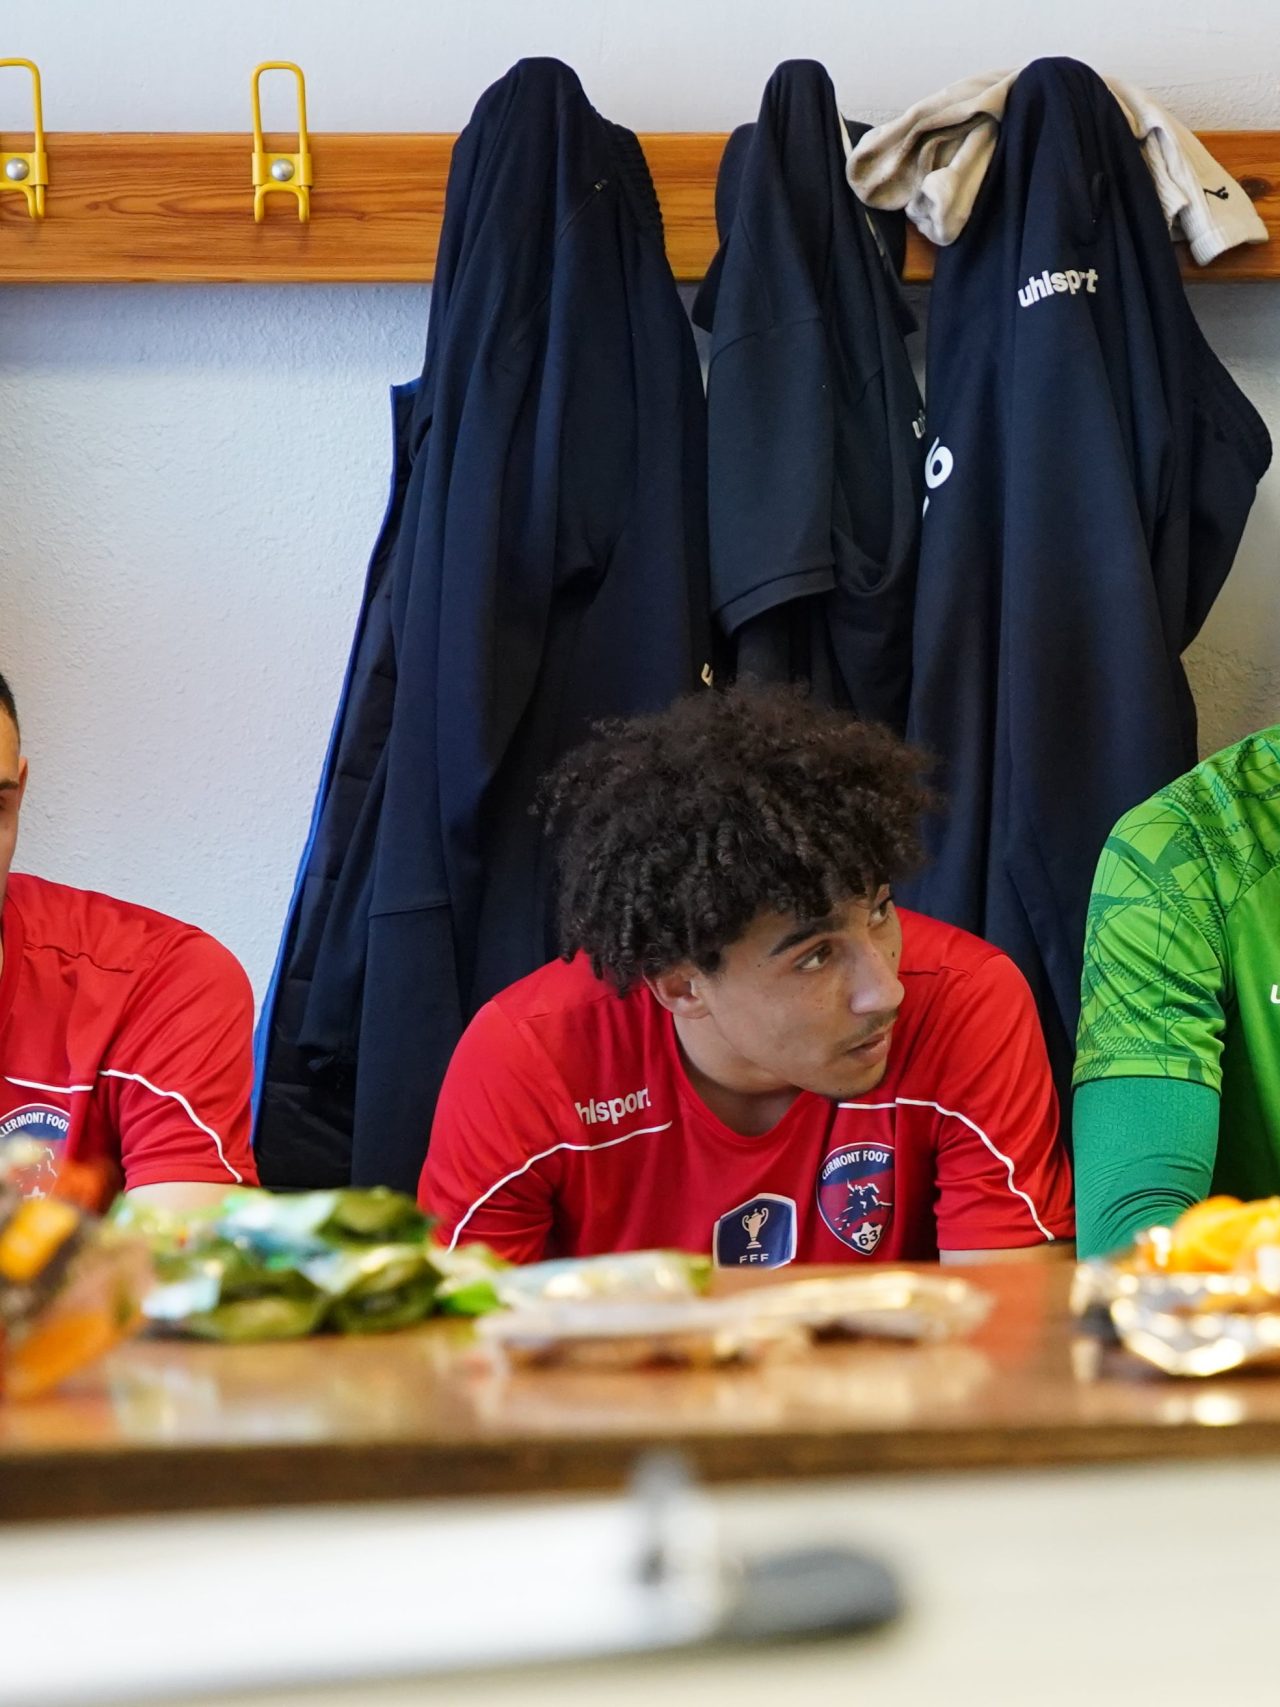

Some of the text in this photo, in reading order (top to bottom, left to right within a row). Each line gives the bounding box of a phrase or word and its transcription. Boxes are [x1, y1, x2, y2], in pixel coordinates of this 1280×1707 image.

[1018, 268, 1099, 308] uhlsprt
[574, 1087, 652, 1125] hlspor
[821, 1150, 890, 1181] CLERMONT FOOT
[858, 1229, 879, 1246] 63
[739, 1253, 769, 1264] FFF
